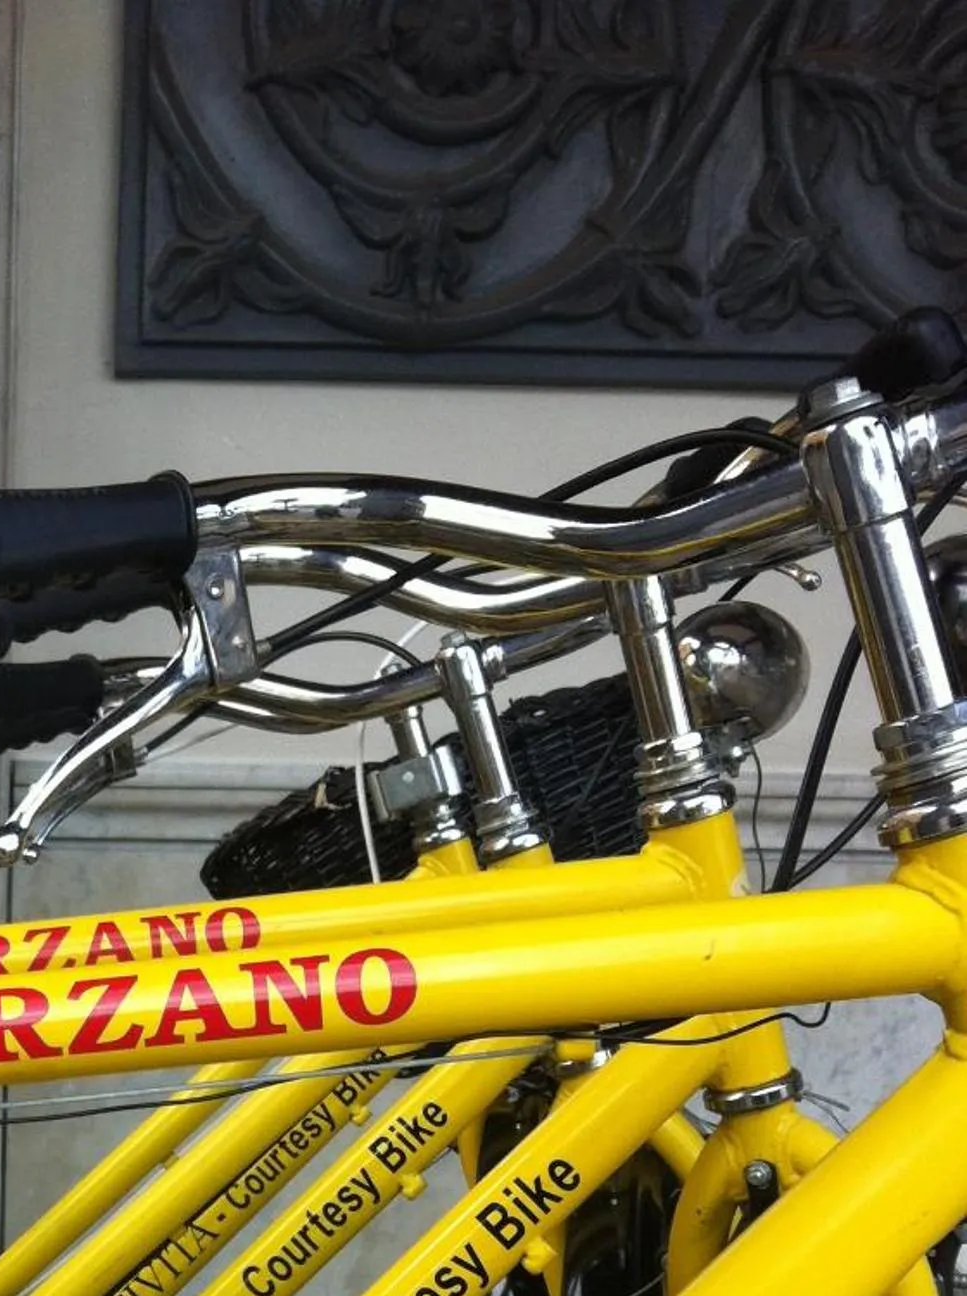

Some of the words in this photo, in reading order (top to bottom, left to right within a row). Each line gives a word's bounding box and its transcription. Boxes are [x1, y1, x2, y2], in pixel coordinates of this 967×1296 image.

[225, 1103, 336, 1209] Courtesy
[368, 1102, 448, 1174] Bike
[475, 1158, 581, 1250] Bike
